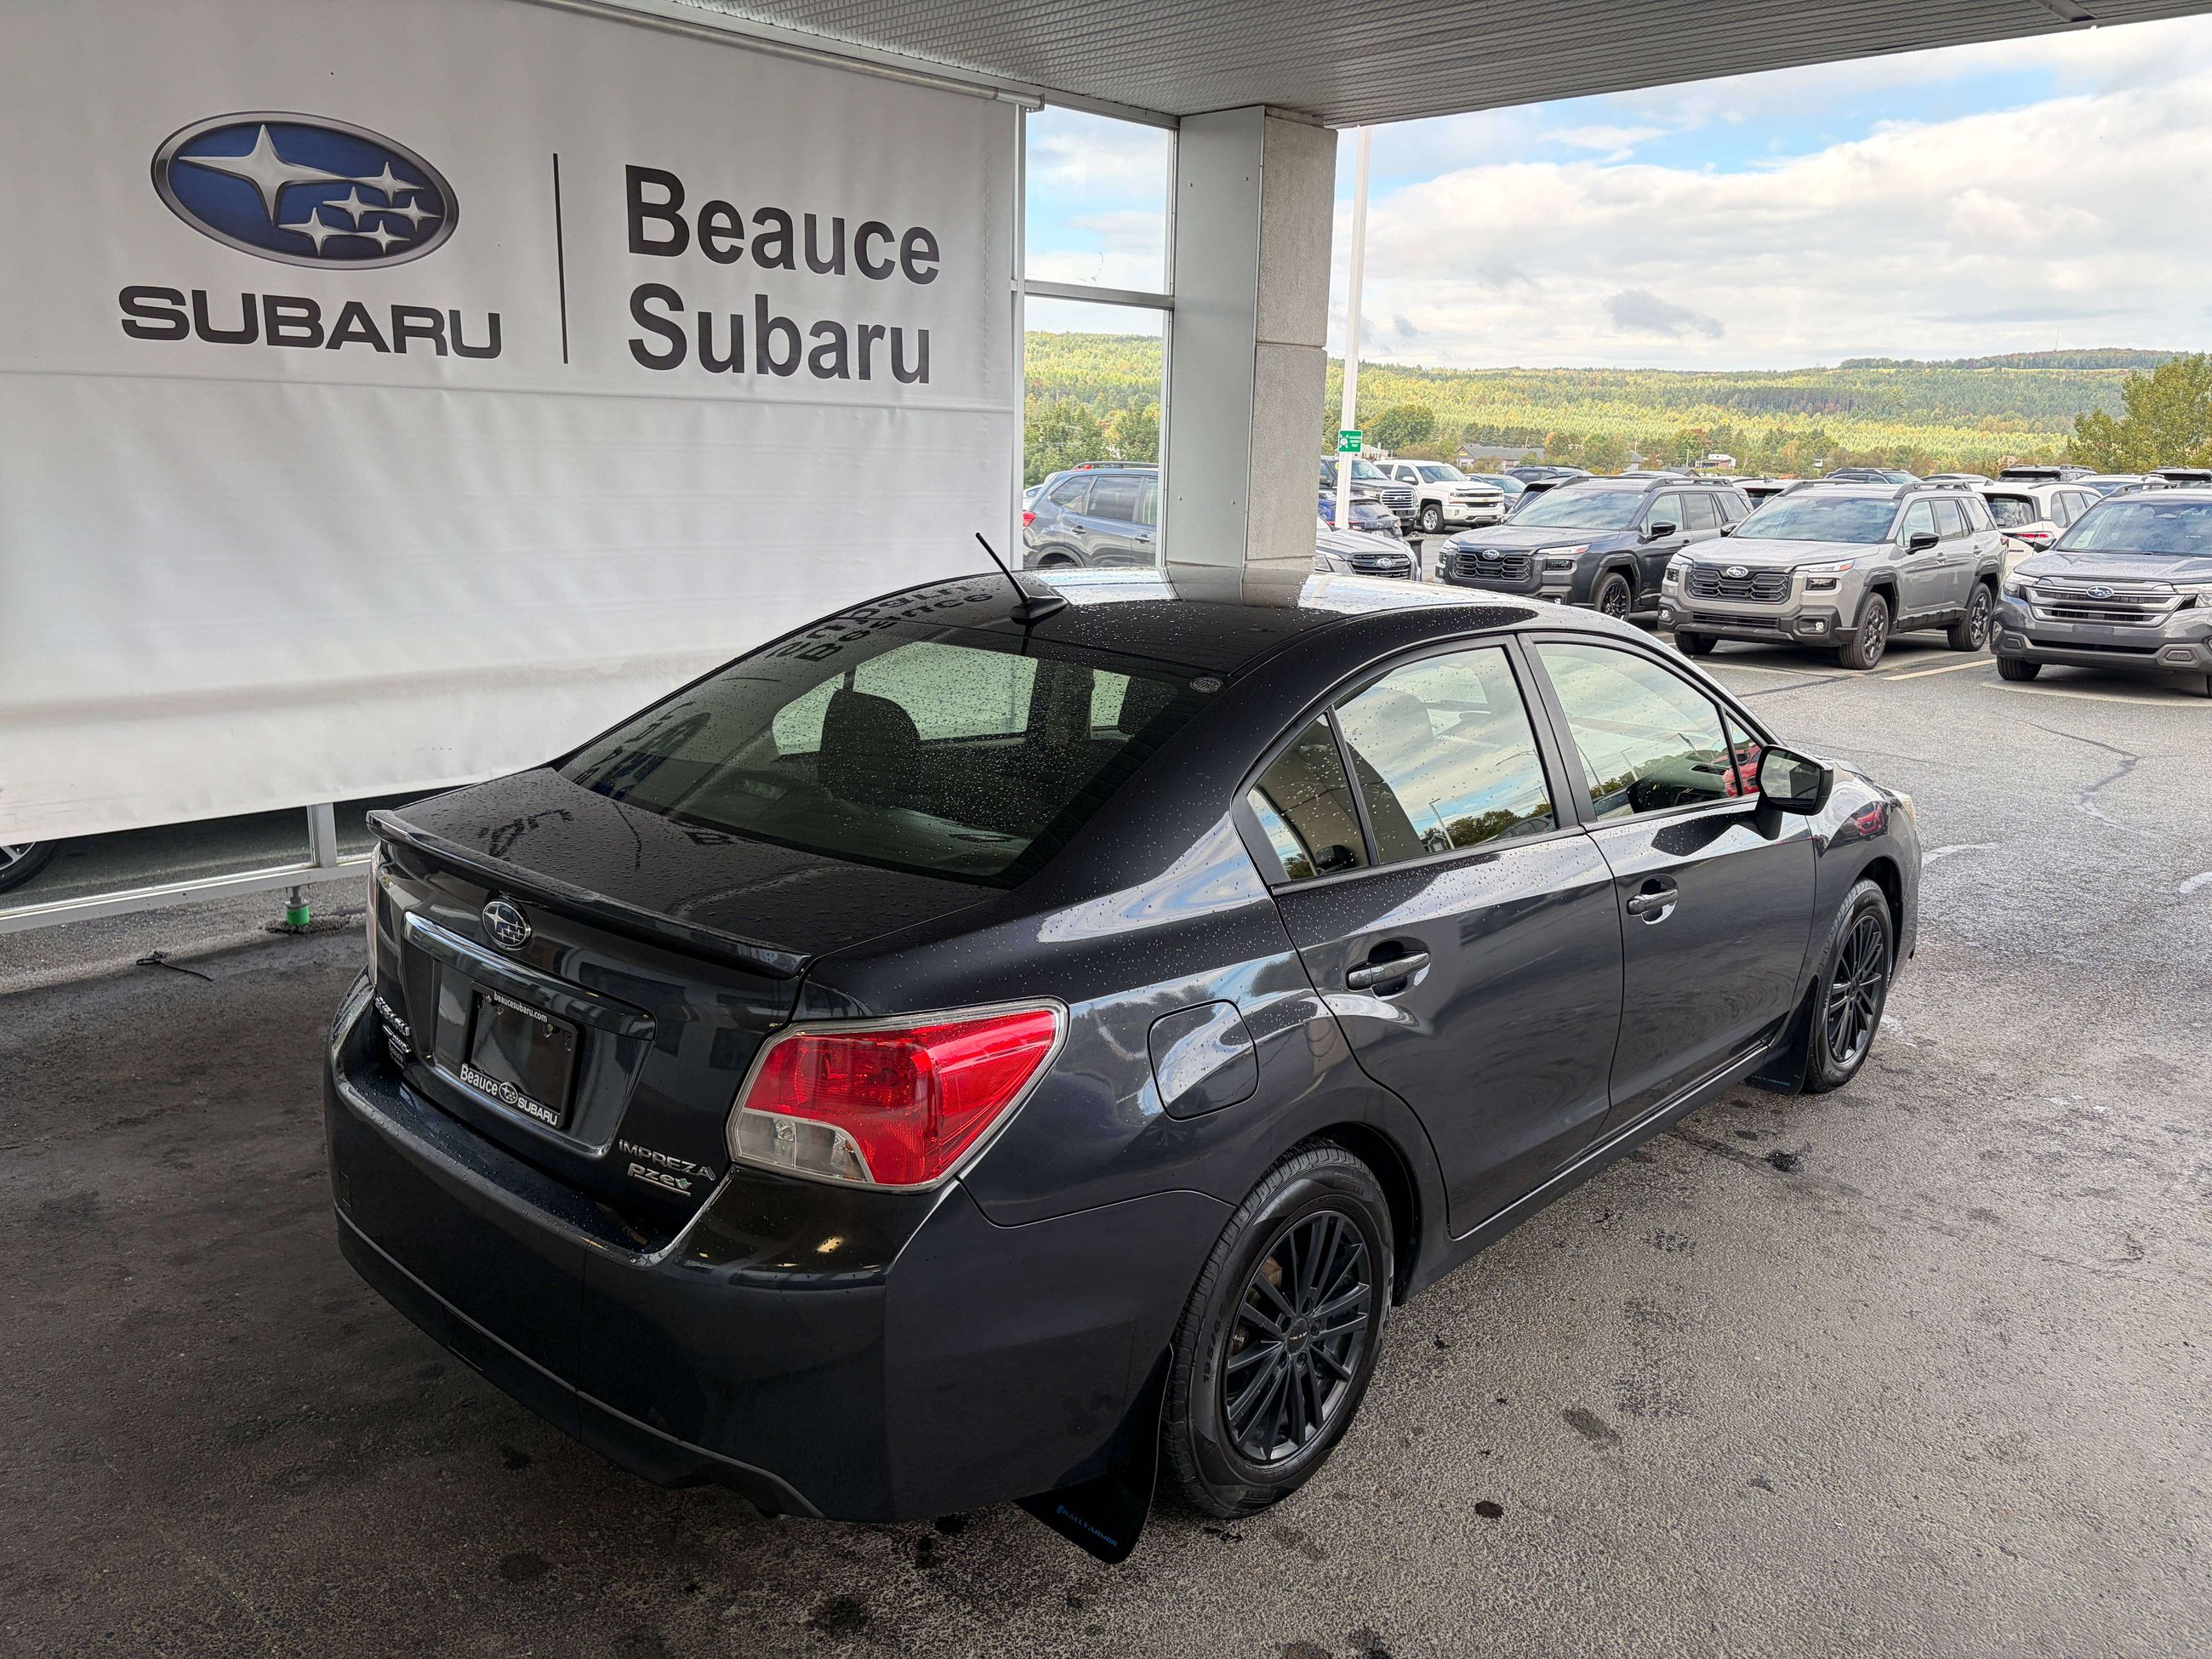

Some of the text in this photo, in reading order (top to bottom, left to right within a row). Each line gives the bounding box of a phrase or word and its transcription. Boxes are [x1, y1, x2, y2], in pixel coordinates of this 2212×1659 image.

[624, 163, 940, 285] Beauce
[118, 285, 502, 359] SUBARU
[628, 282, 933, 385] Subaru
[493, 991, 548, 1023] beaucesubaru.com
[460, 1064, 558, 1126] Beauce SUBARU
[619, 1138, 716, 1182] IMPREZA
